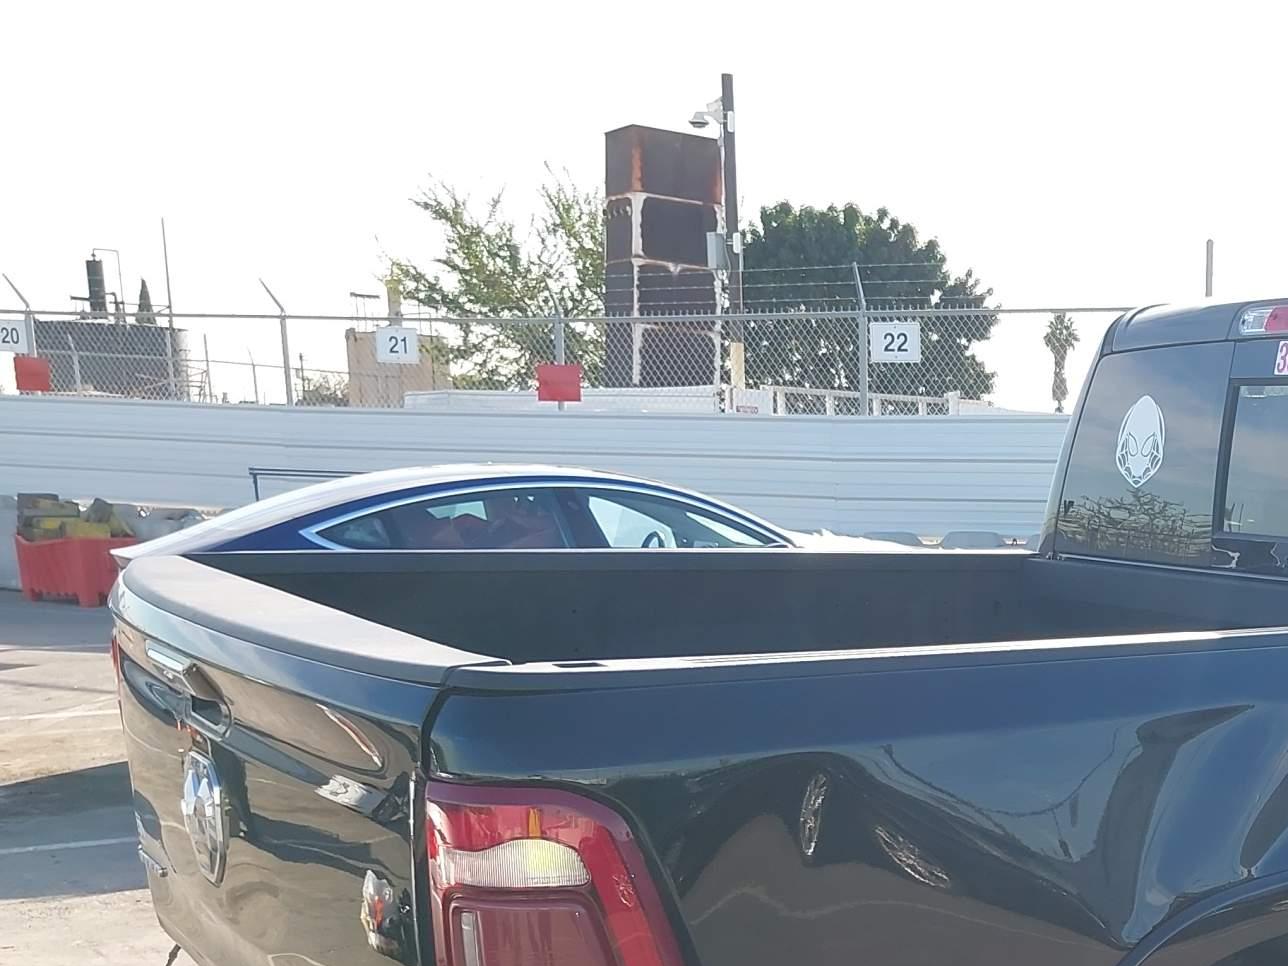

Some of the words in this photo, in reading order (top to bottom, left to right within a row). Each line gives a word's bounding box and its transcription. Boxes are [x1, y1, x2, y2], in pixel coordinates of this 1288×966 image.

[0, 327, 20, 345] 20
[388, 335, 408, 354] 21
[883, 332, 909, 352] 22
